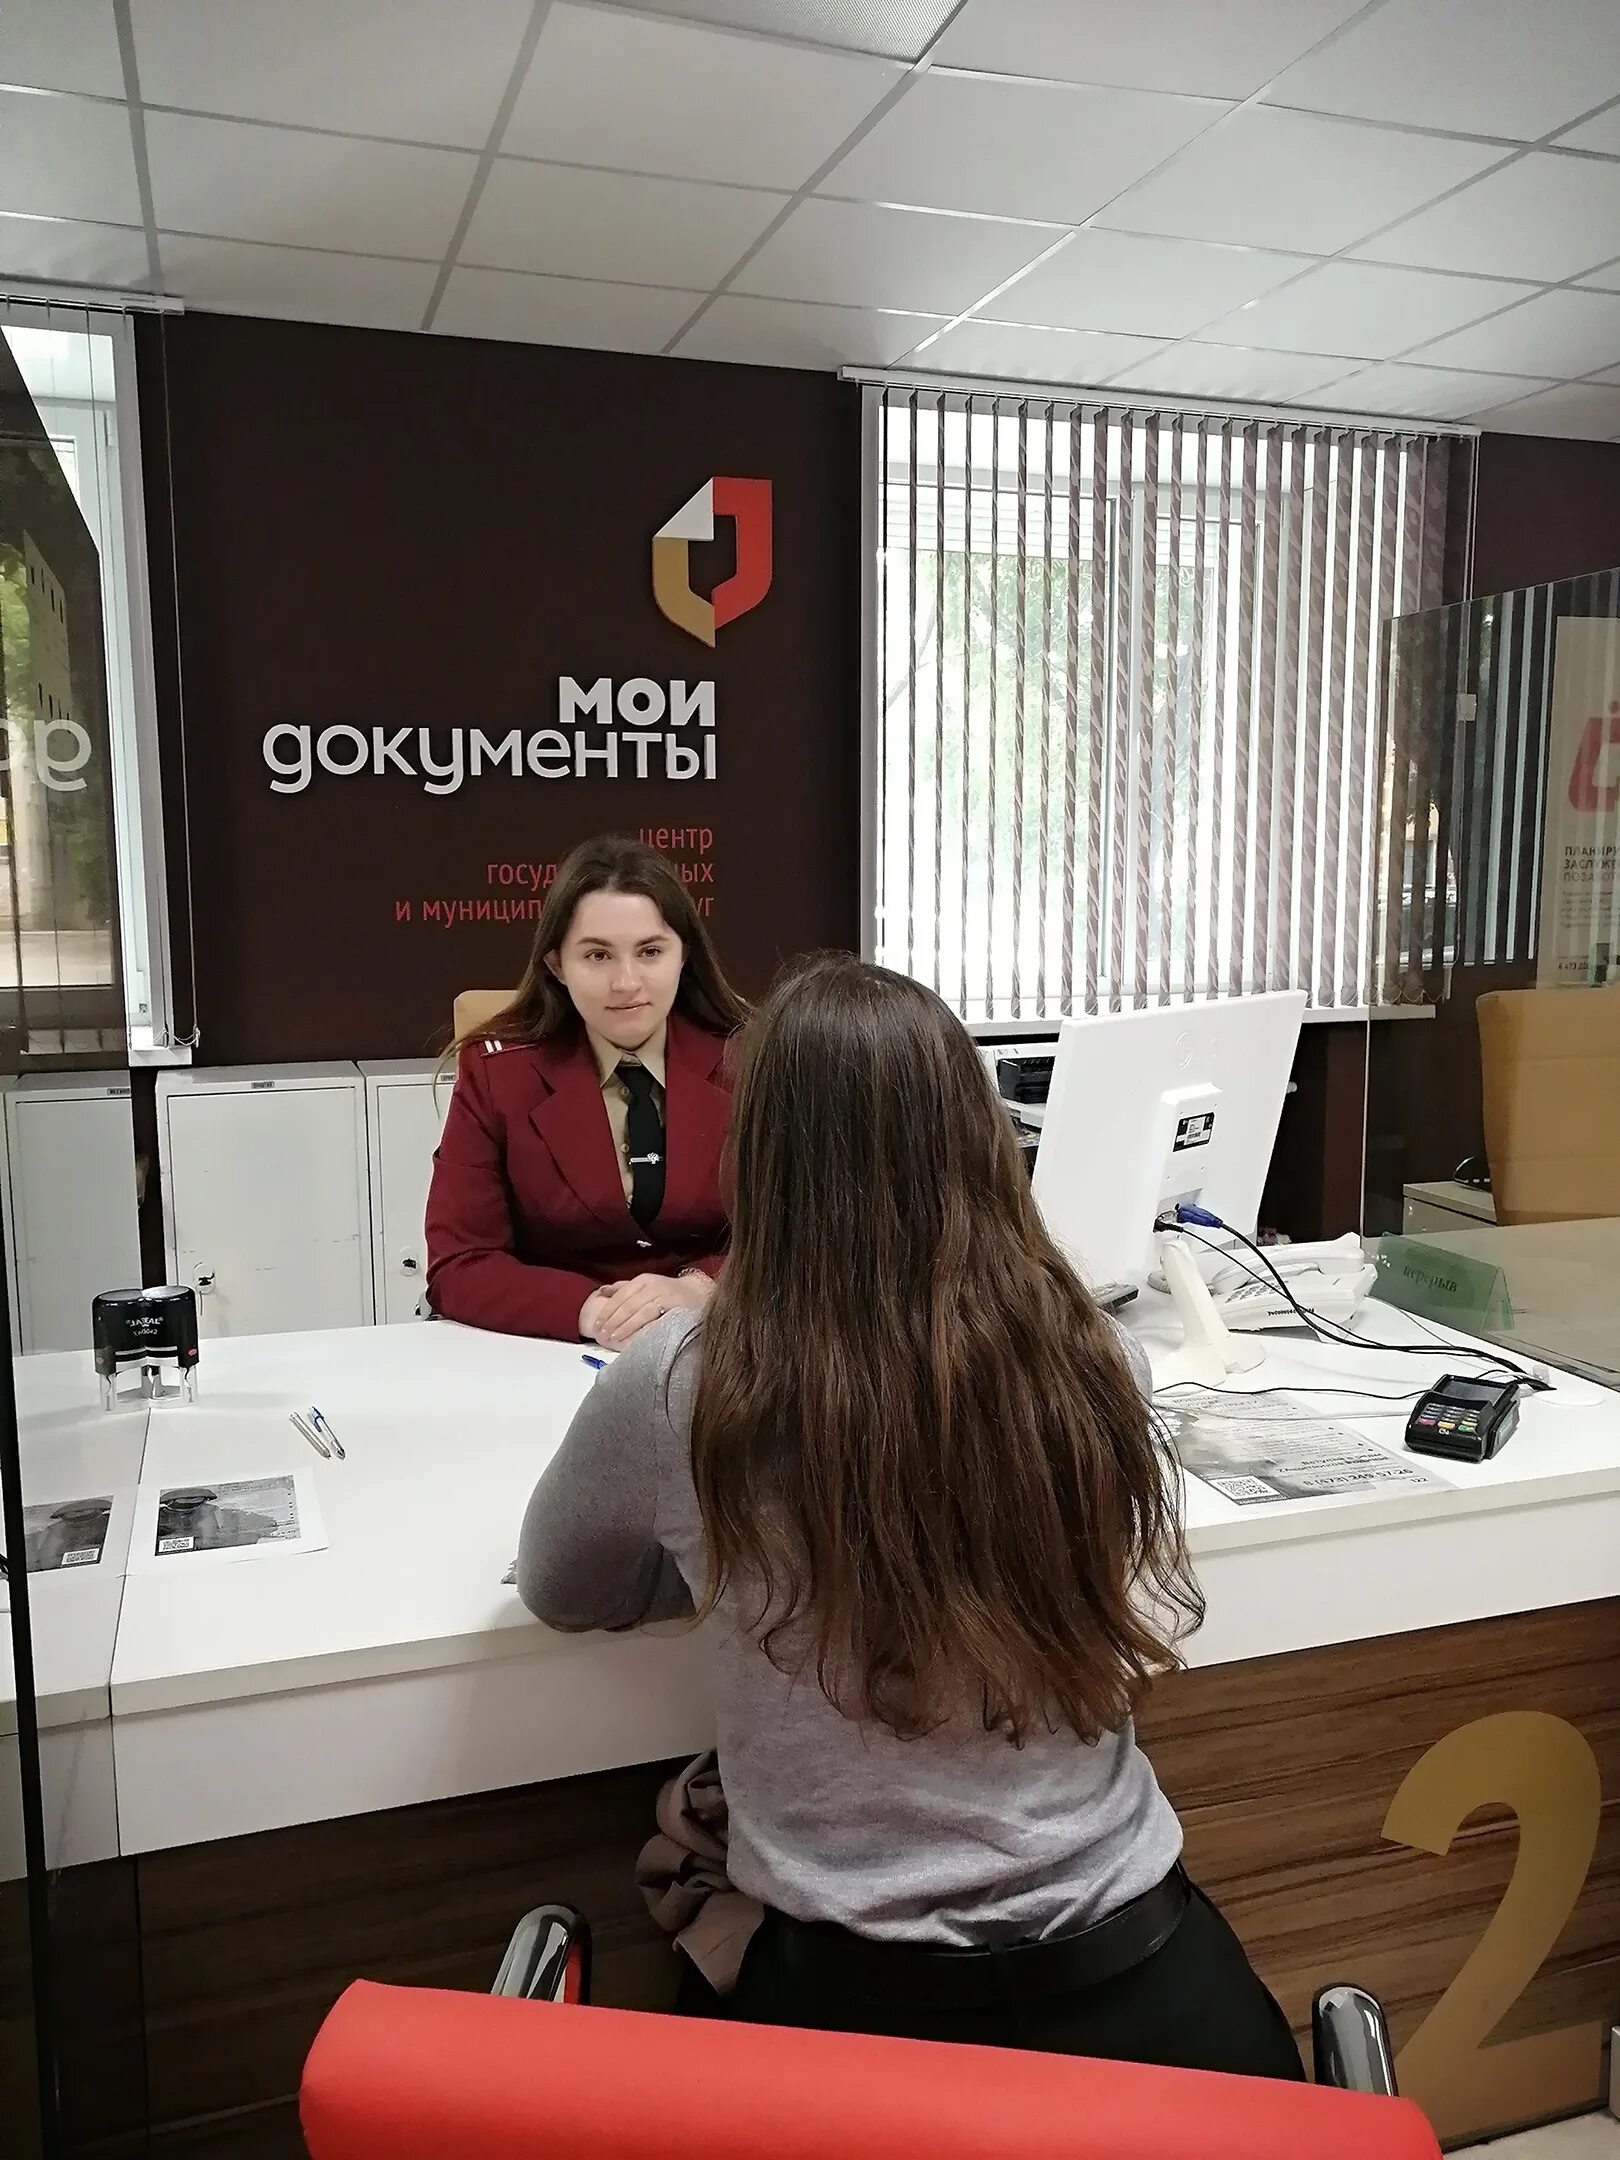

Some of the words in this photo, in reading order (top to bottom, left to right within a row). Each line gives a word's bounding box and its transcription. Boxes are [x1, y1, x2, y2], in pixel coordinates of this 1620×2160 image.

[639, 827, 714, 854] центр
[395, 901, 411, 922] и
[1380, 1710, 1602, 2142] 2
